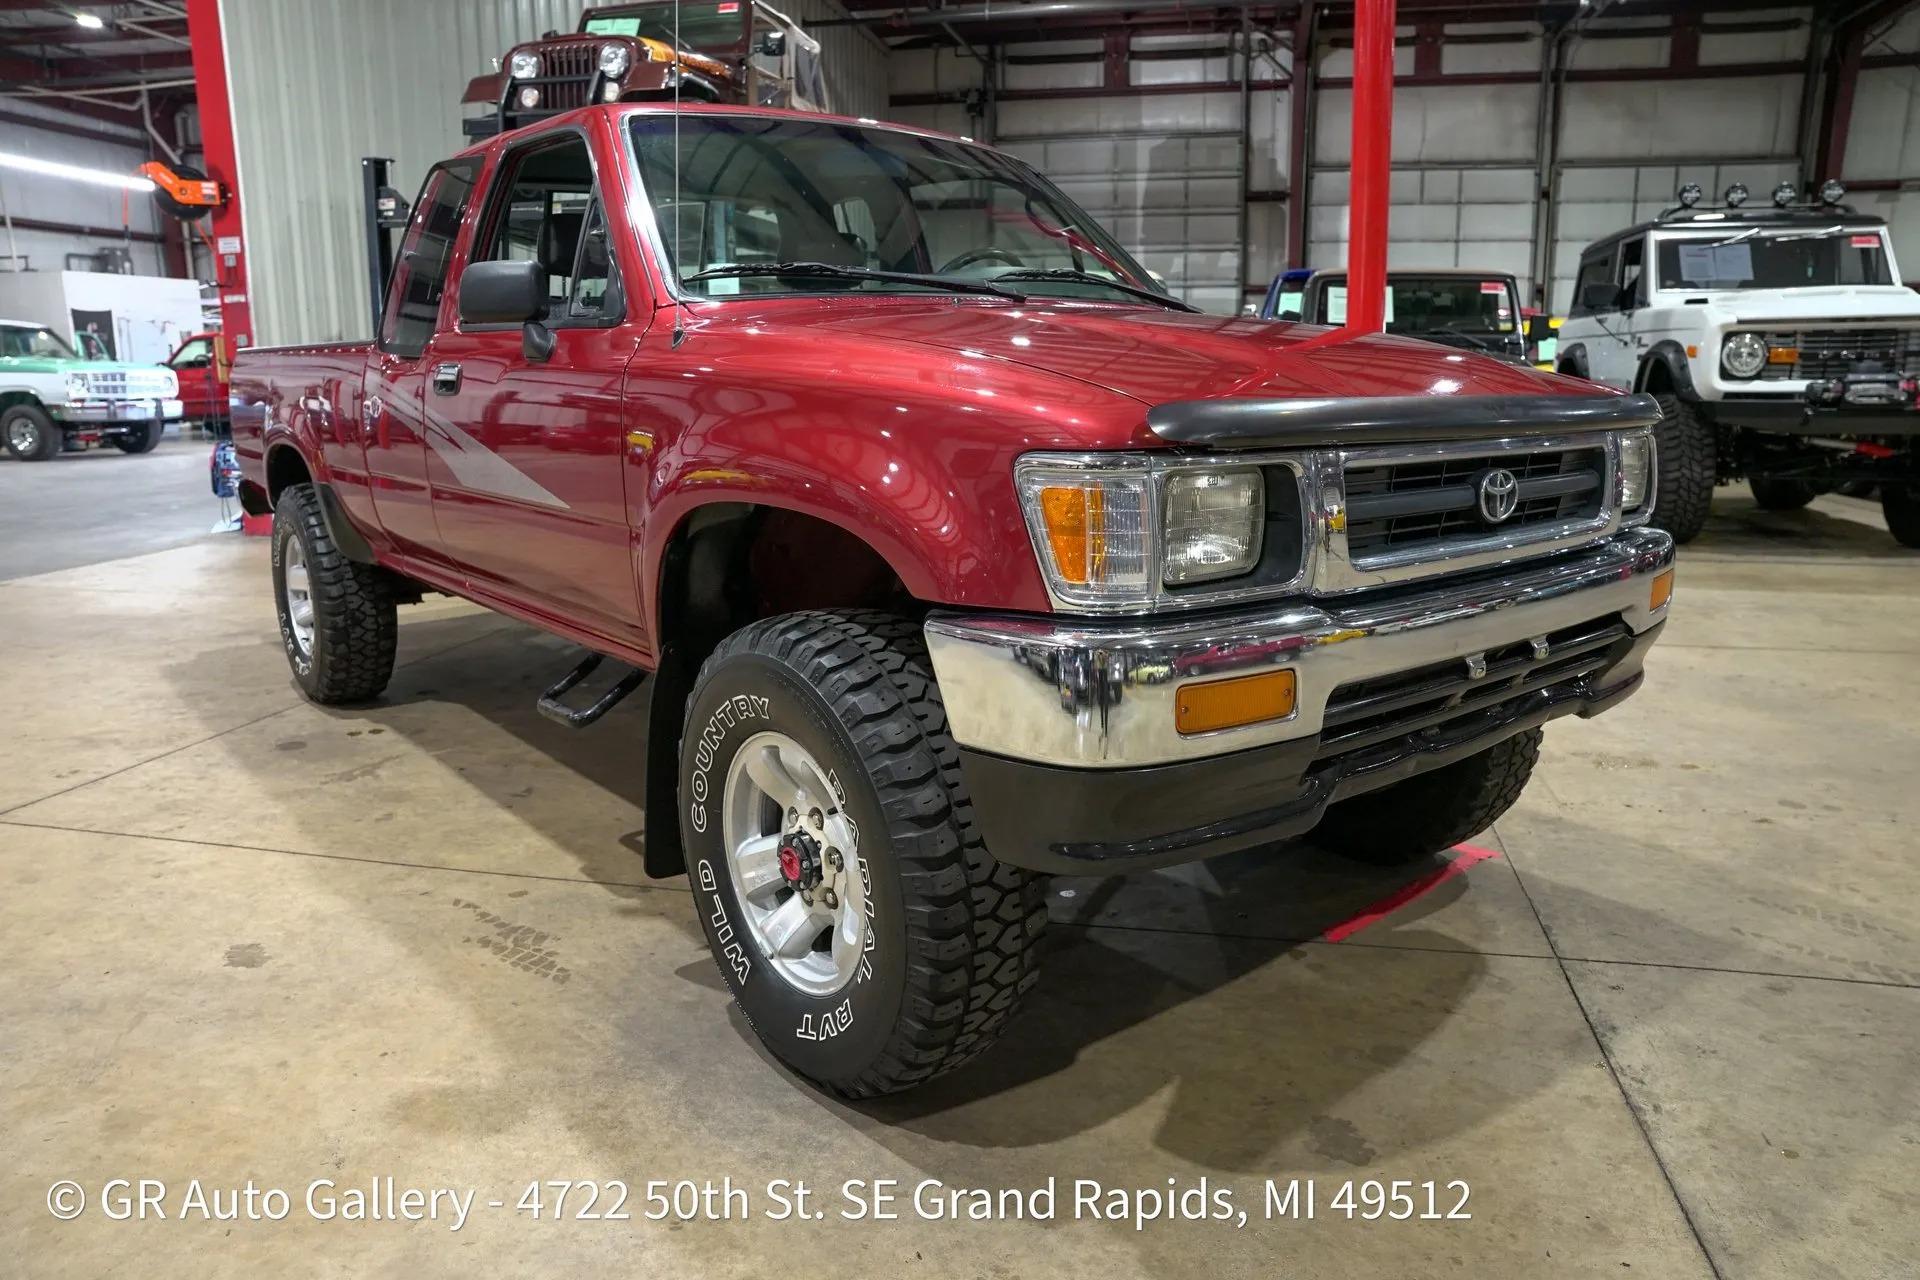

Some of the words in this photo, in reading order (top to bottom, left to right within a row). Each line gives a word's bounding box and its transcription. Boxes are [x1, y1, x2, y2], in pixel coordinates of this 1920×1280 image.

[690, 694, 771, 833] COUNTRY
[698, 858, 753, 986] WILD
[796, 998, 854, 1041] RVT
